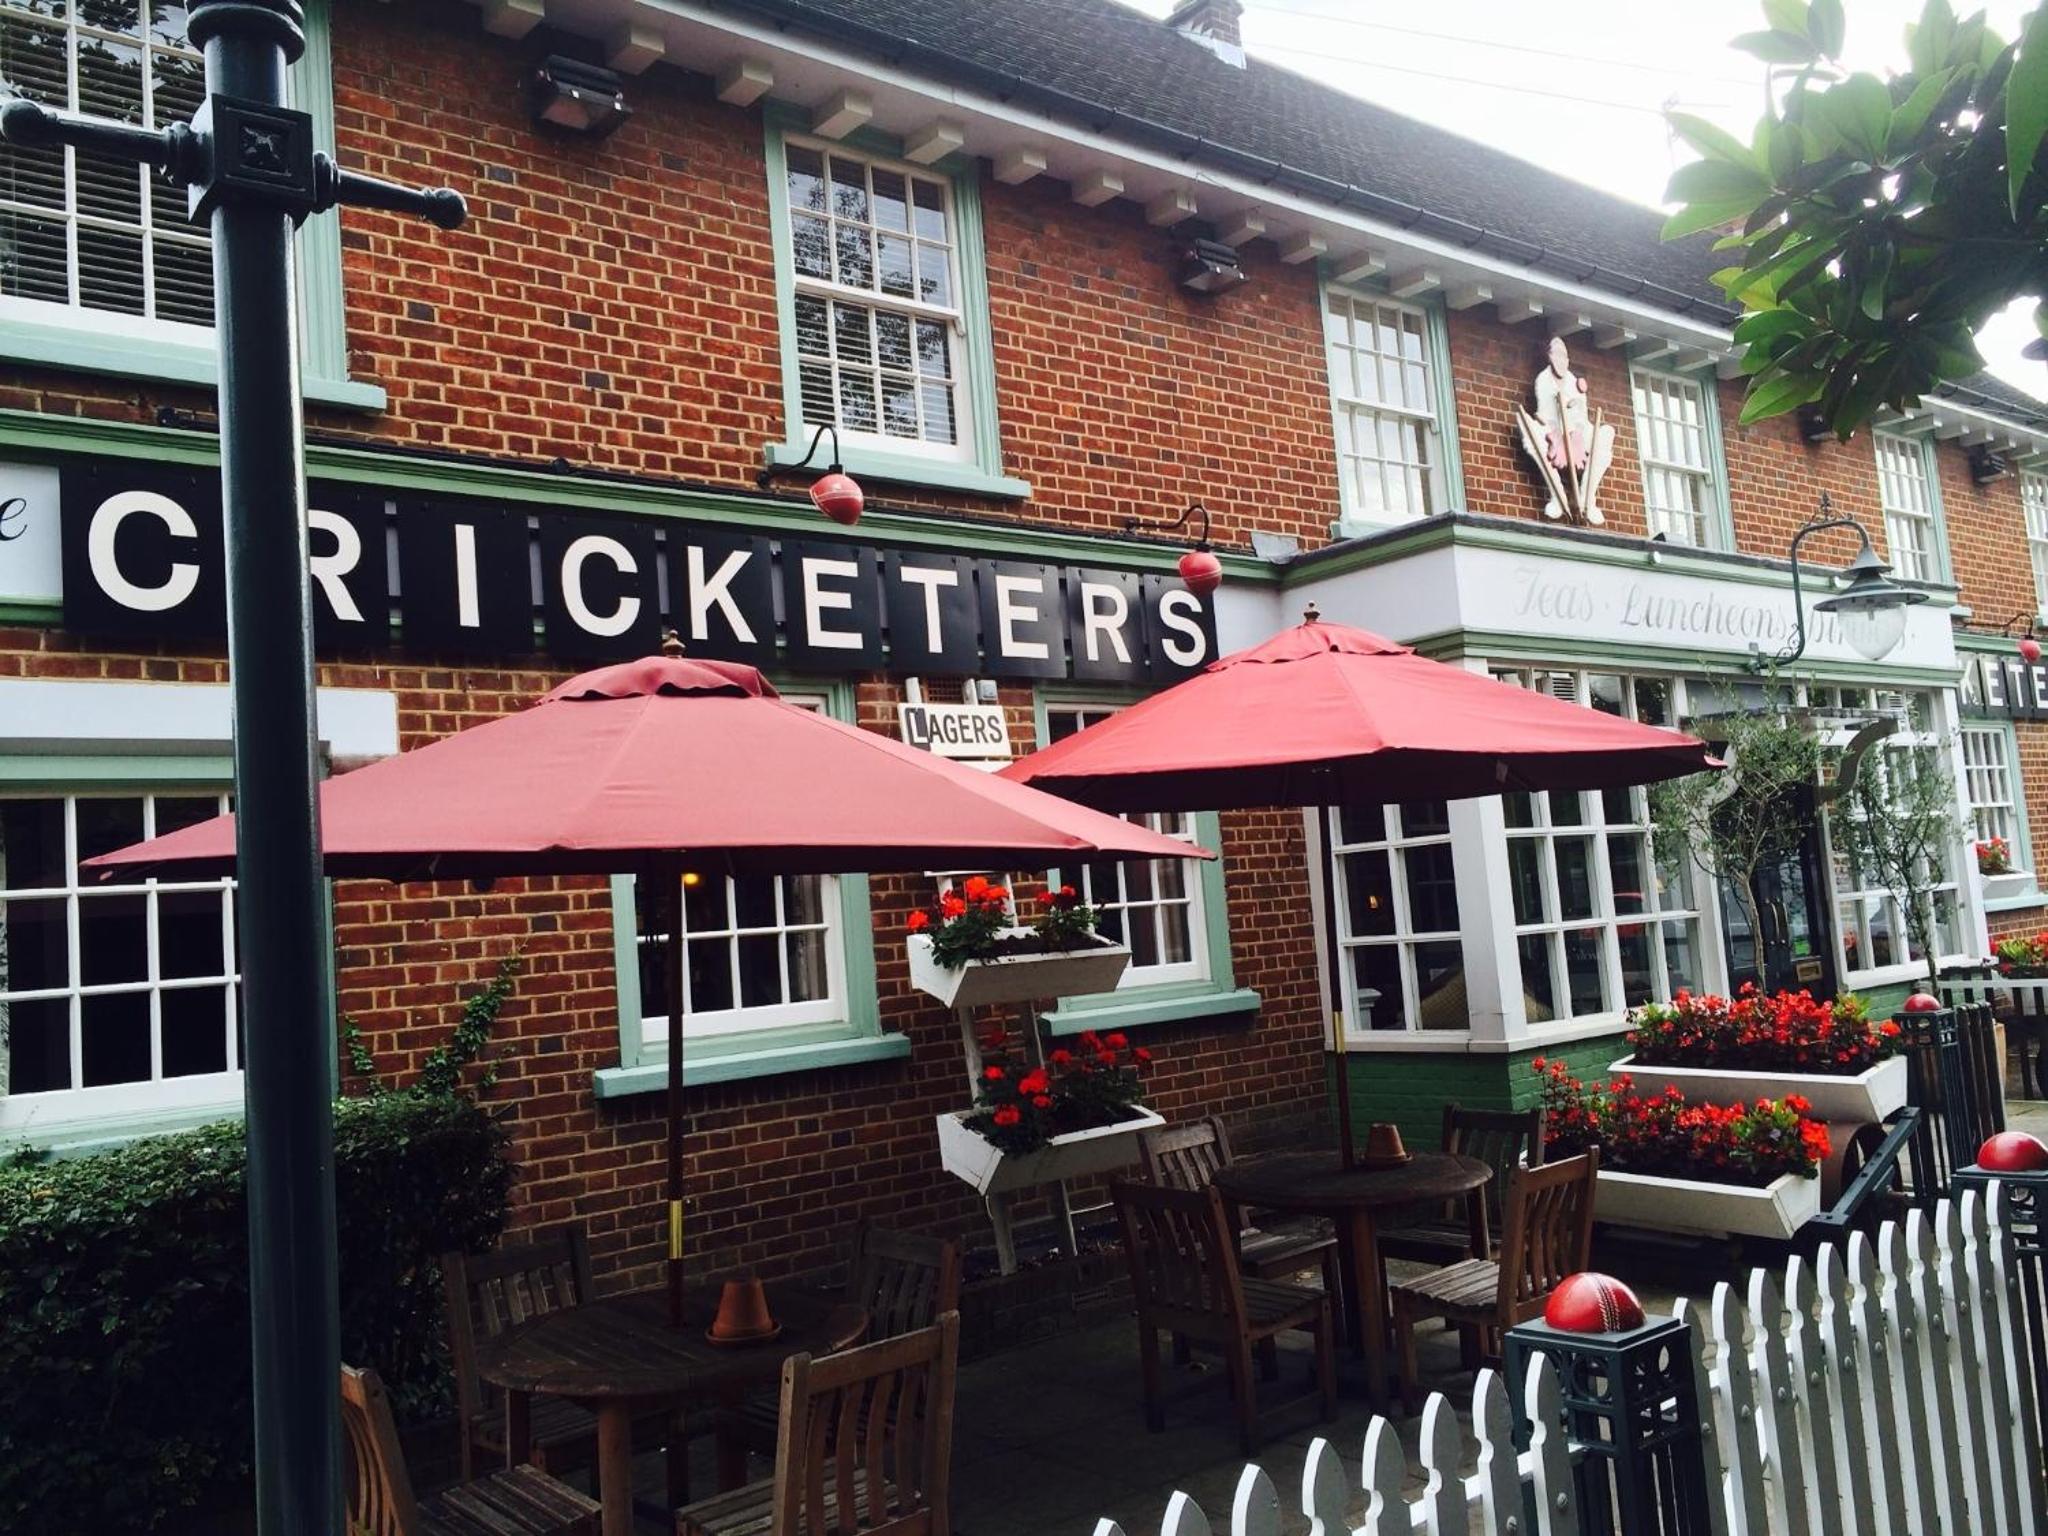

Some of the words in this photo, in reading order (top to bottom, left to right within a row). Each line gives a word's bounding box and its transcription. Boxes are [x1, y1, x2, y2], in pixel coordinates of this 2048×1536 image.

[88, 490, 1207, 667] CRICKETERS
[1514, 568, 1594, 623] Teas
[1620, 580, 1787, 641] Luncheons
[907, 710, 1003, 745] LAGERS
